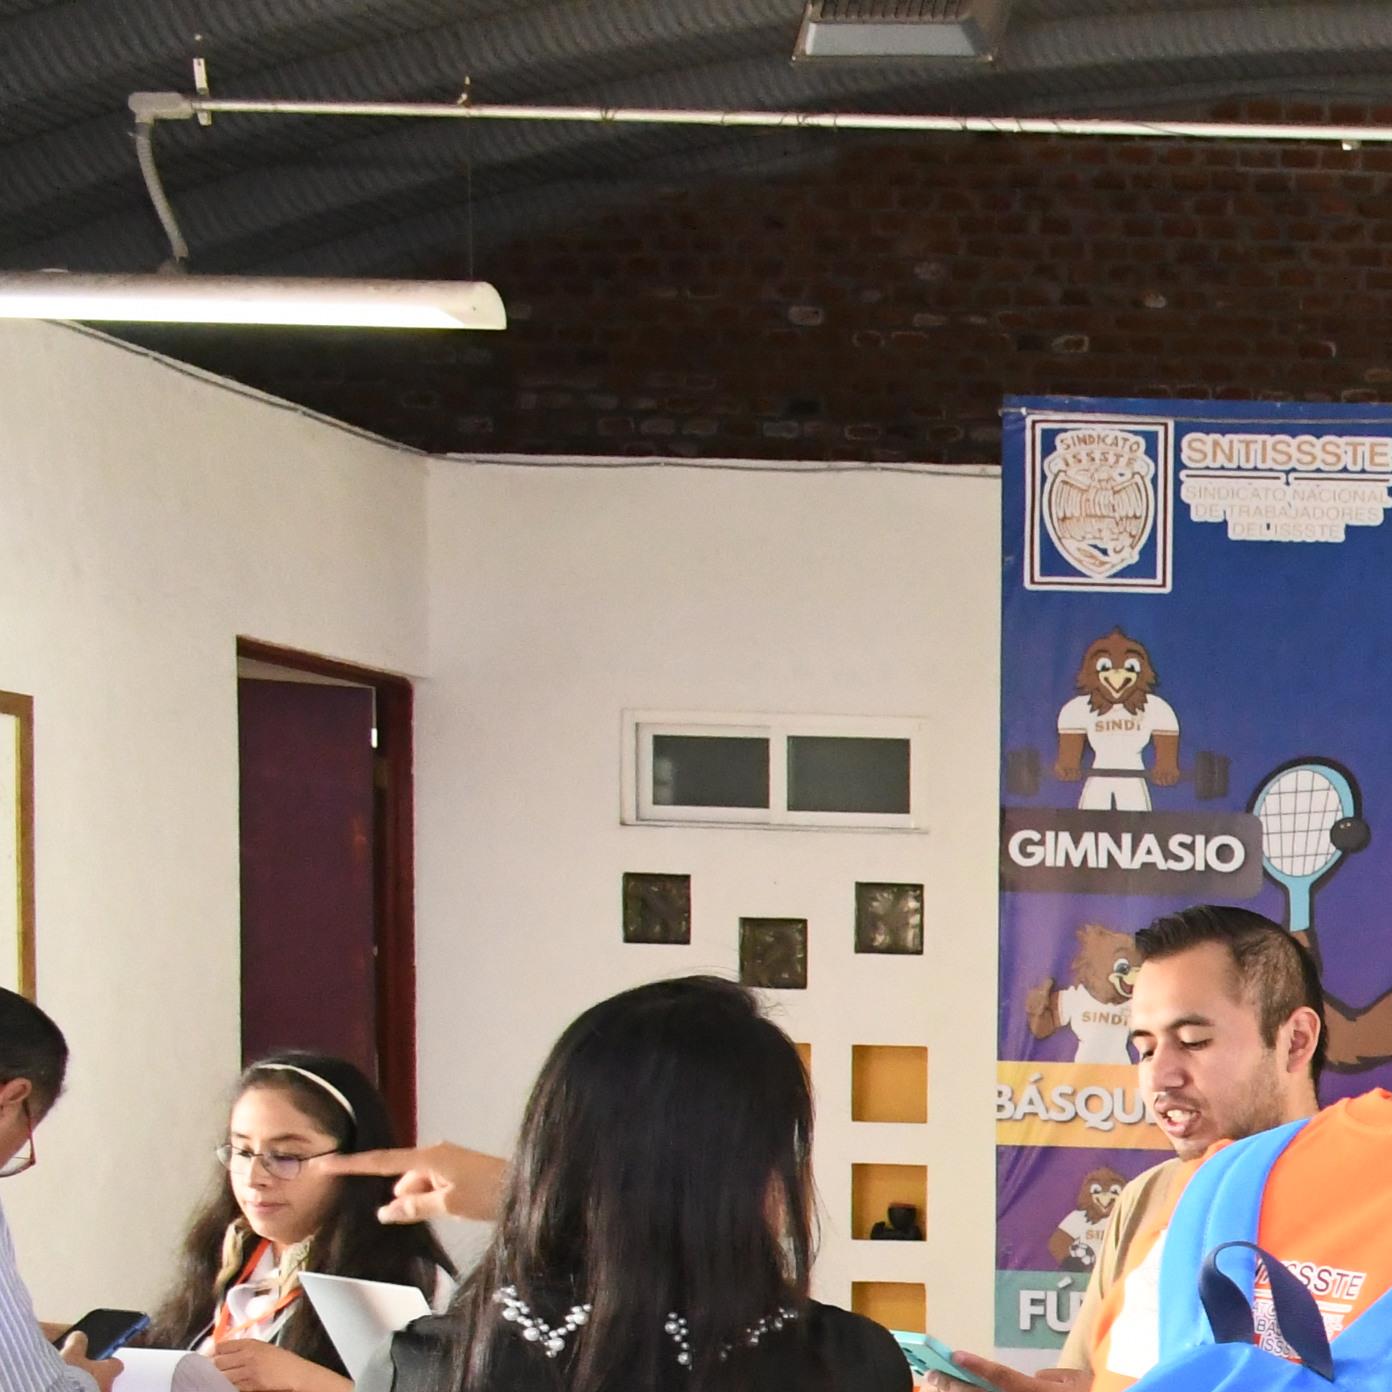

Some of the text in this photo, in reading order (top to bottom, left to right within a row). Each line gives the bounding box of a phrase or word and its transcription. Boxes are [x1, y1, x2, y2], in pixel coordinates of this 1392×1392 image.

[1059, 433, 1141, 454] SINDICATO
[1186, 437, 1391, 467] SNTISSSTE
[1185, 484, 1390, 503] SINDICATO NACIONAL
[1194, 504, 1379, 522] DE TRABAJADORES
[1232, 522, 1340, 539] DEL ISSSTE
[1008, 829, 1246, 873] GIMNASIO
[994, 1073, 1160, 1131] BÁSQU
[1019, 1277, 1083, 1334] FÚ
